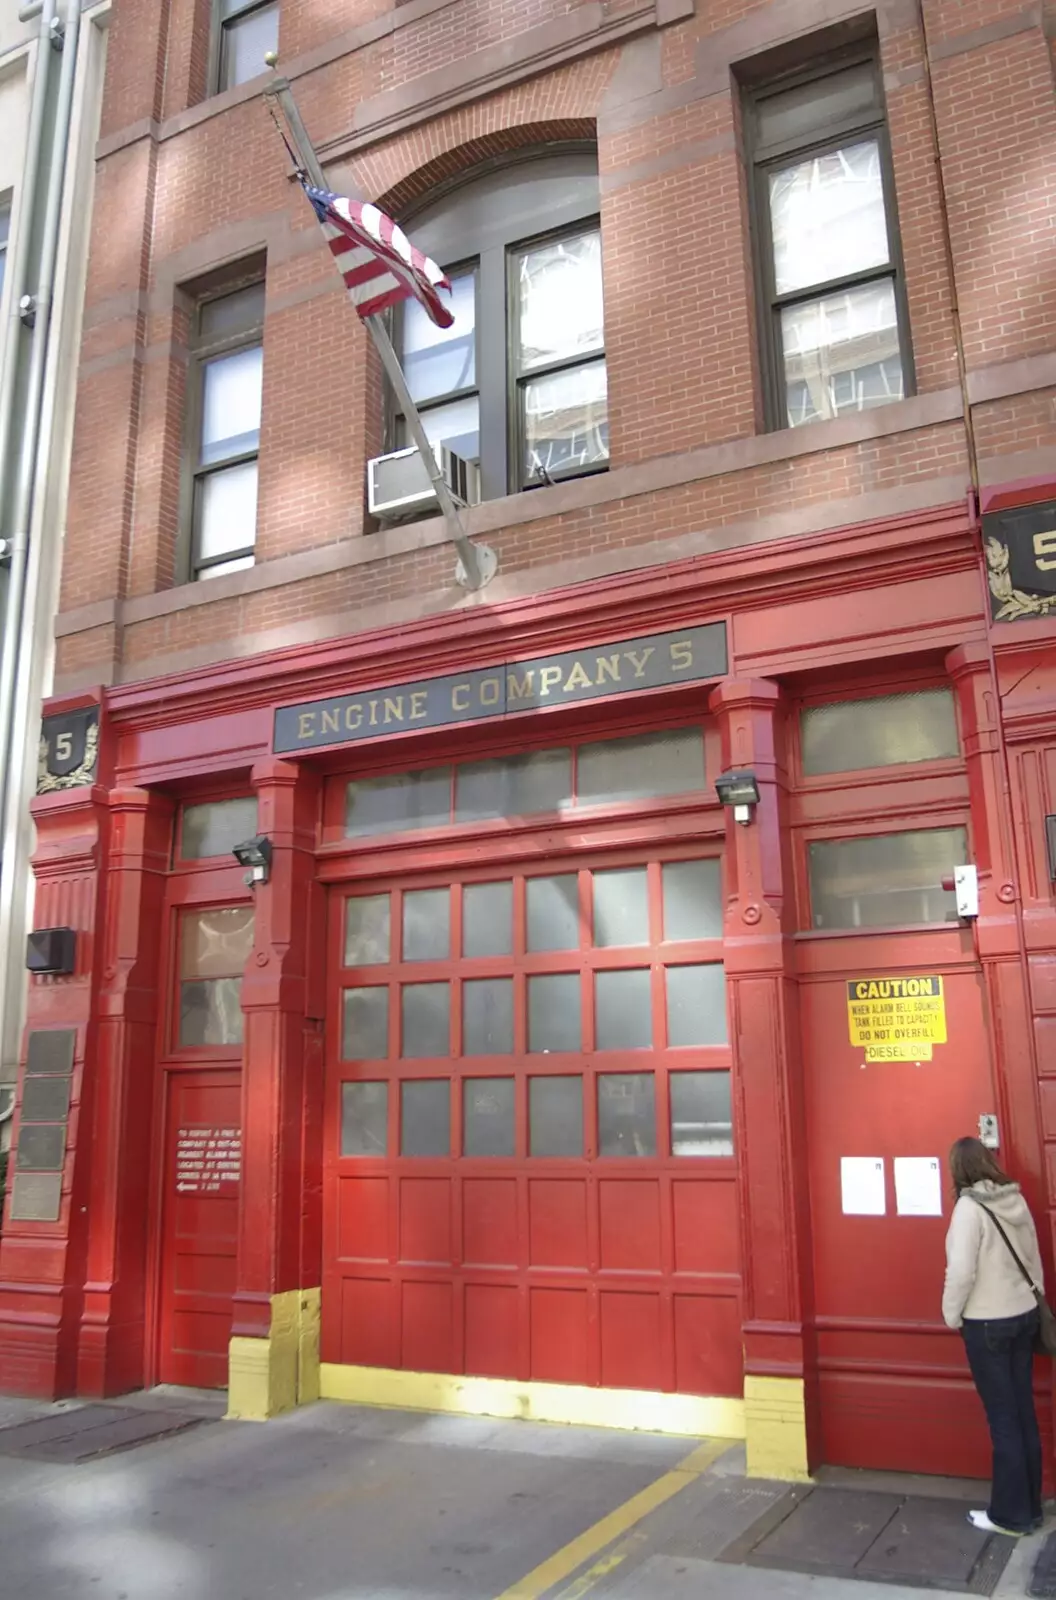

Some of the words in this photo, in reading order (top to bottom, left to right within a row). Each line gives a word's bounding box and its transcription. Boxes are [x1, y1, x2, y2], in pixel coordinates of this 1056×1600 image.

[1033, 530, 1056, 571] 5
[297, 692, 428, 739] ENGINE
[451, 647, 656, 712] COMPANY
[670, 641, 694, 671] 5
[56, 732, 73, 761] 5
[856, 978, 933, 999] CAUTION
[852, 1005, 870, 1016] WHEN
[872, 1003, 894, 1014] ALARM
[896, 1002, 911, 1013] BELL
[854, 1016, 870, 1027] TANK
[872, 1015, 894, 1027] FILLED
[896, 1015, 905, 1025] TO
[907, 1013, 938, 1025] CAPACITY
[859, 1030, 871, 1041] DO
[874, 1029, 891, 1040] NOT
[894, 1028, 935, 1039] OVERFILL
[869, 1046, 906, 1058] DIESEL
[911, 1045, 928, 1056] OIL
